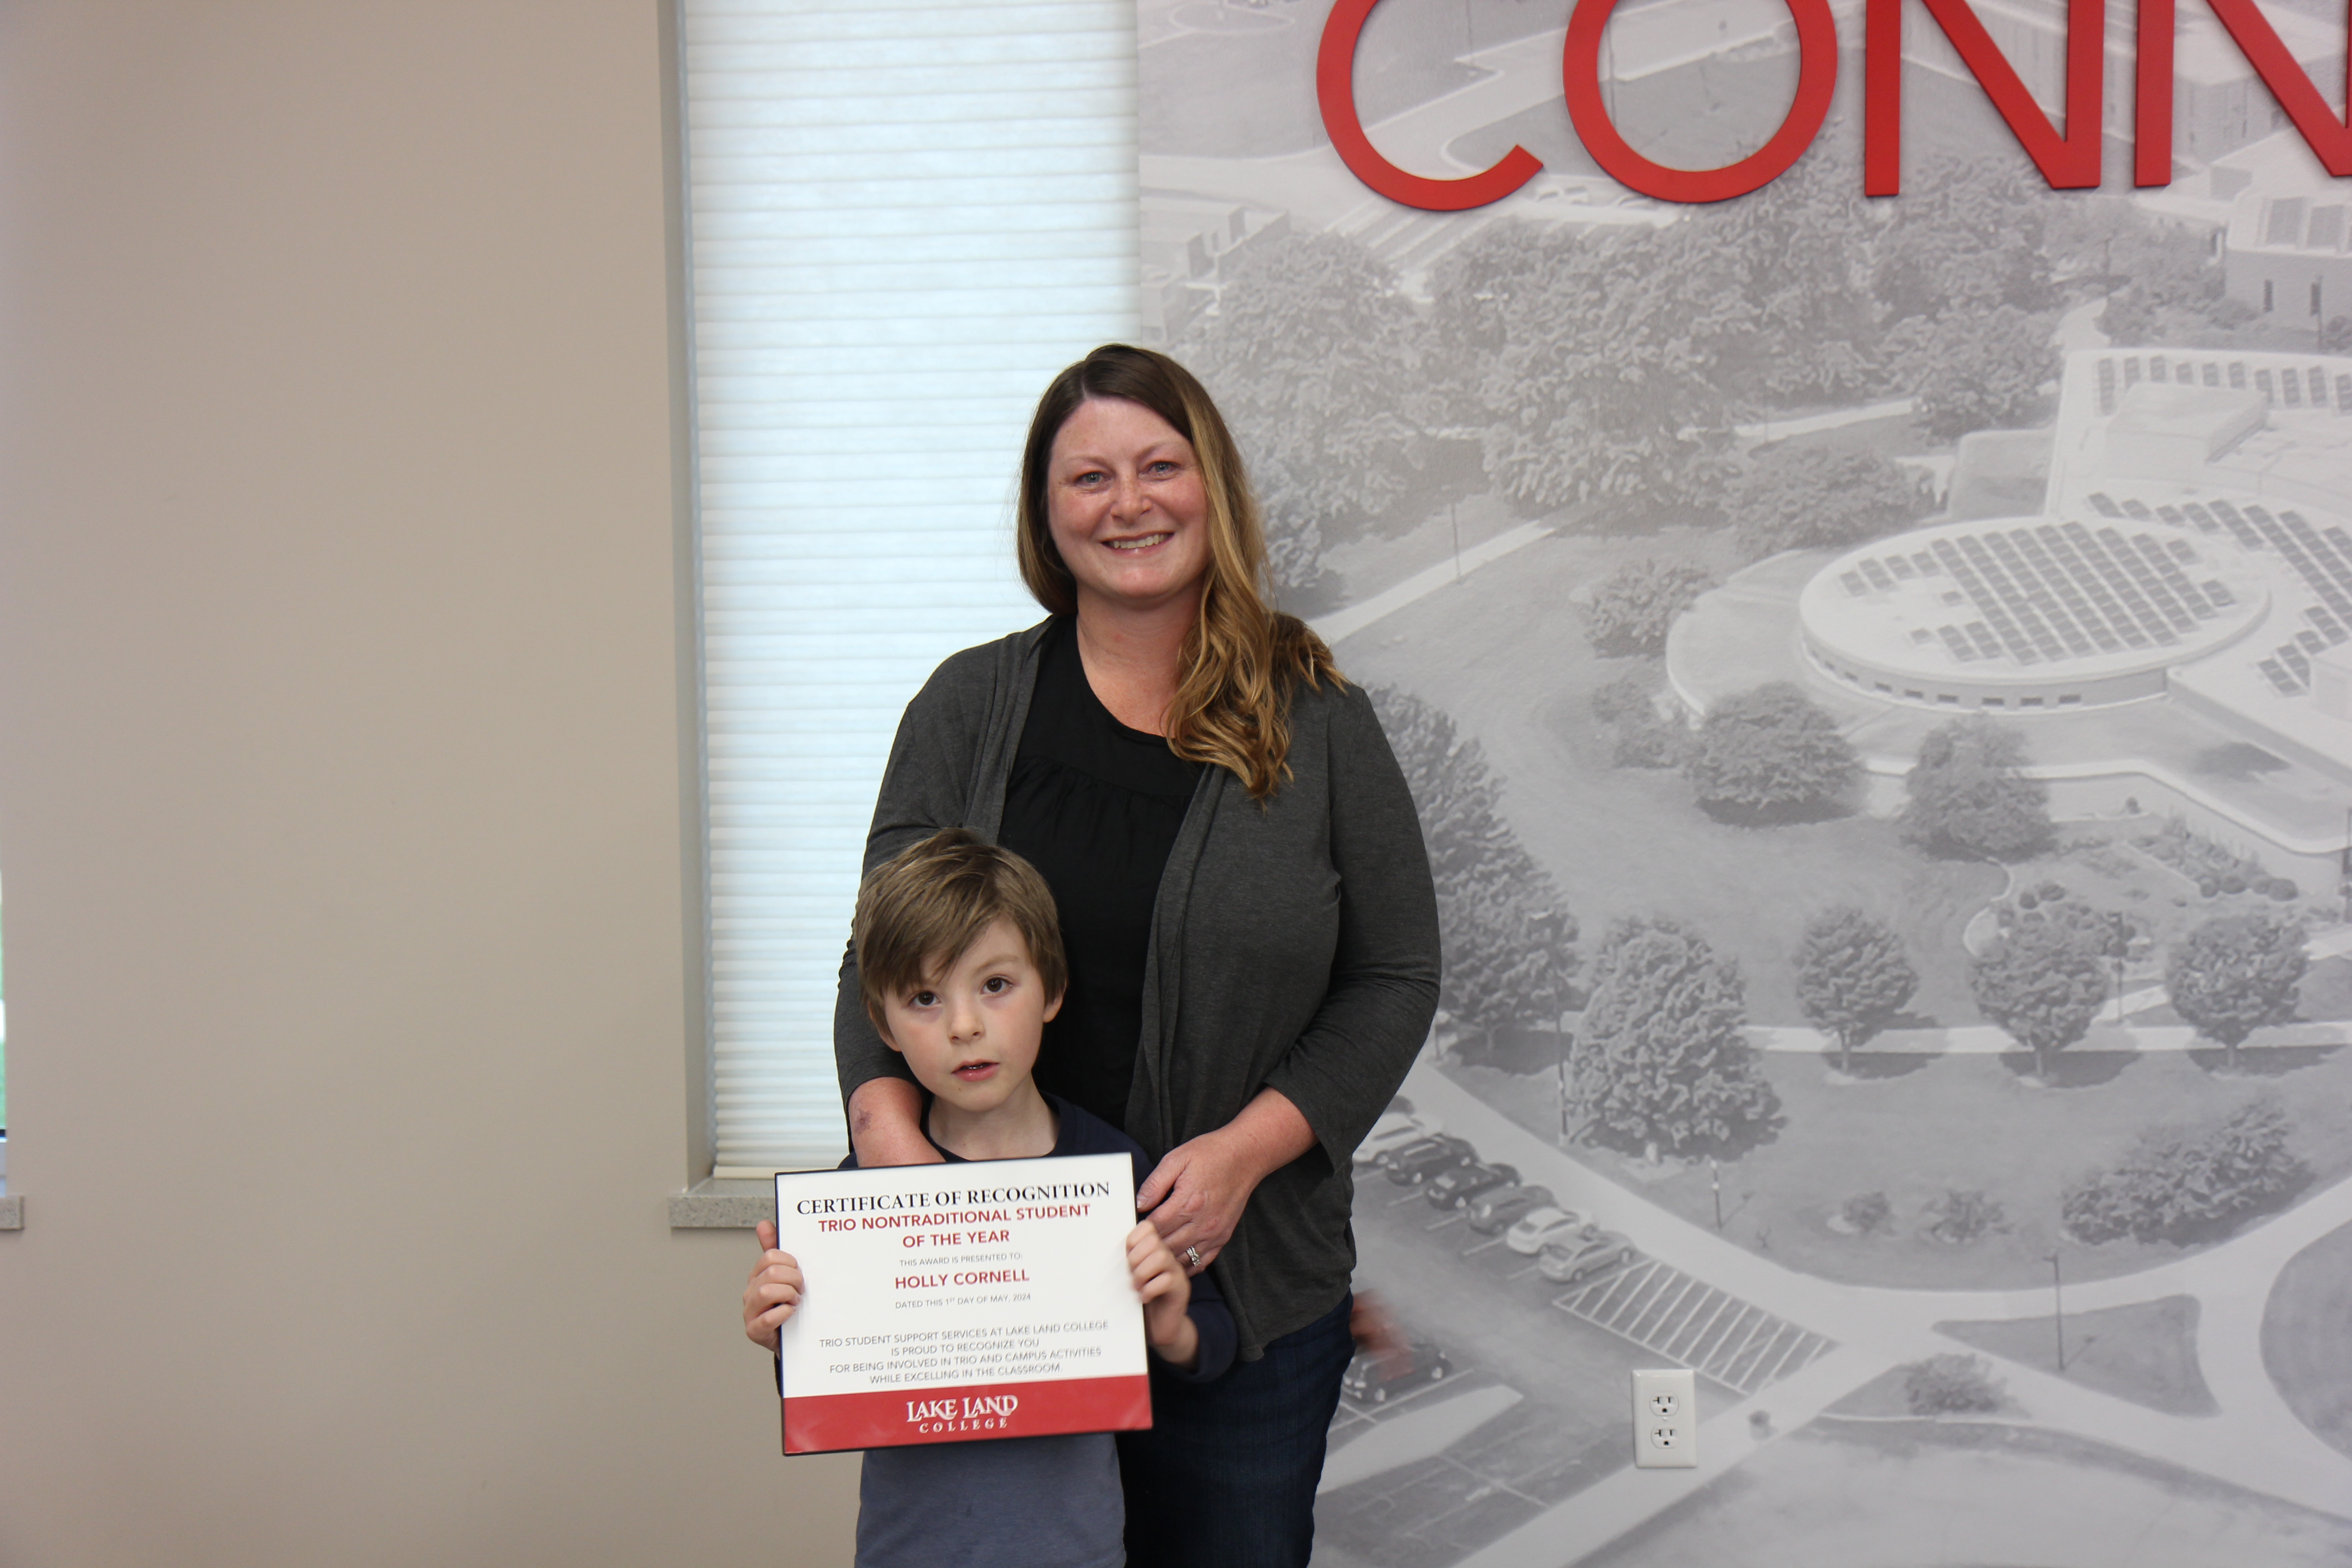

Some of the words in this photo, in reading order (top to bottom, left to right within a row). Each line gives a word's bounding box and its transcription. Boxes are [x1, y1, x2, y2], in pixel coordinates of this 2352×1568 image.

[797, 1193, 930, 1215] CERTIFICATE
[935, 1190, 961, 1206] OF
[967, 1181, 1109, 1204] RECOGNITION
[818, 1219, 856, 1232] TRIO
[862, 1209, 1011, 1230] NONTRADITIONAL
[1016, 1203, 1090, 1220] STUDENT
[903, 1235, 925, 1248] OF
[931, 1233, 961, 1246] THE
[967, 1229, 1009, 1244] YEAR
[919, 1257, 949, 1265] AWARD
[961, 1253, 1007, 1263] PRESENTED
[1010, 1252, 1022, 1260] TO:
[895, 1274, 949, 1289] HOLLY
[954, 1269, 1029, 1285] CORNELL
[895, 1300, 923, 1309] DATED
[925, 1298, 943, 1307] THIS
[958, 1296, 974, 1305] DAY
[976, 1294, 988, 1304] OF
[990, 1294, 1010, 1303] MAY,
[1013, 1293, 1031, 1302] 2024
[819, 1338, 843, 1348] TRIO
[845, 1335, 892, 1346] STUDENT
[894, 1331, 939, 1343] SUPPORT
[941, 1328, 987, 1340] SERVICES
[990, 1327, 1003, 1336] AT
[1006, 1324, 1029, 1336] LAKE
[1033, 1323, 1061, 1334] LAND
[1063, 1319, 1108, 1332] COLLEGE
[891, 1347, 899, 1356] IS
[903, 1345, 937, 1356] PROUD
[940, 1343, 954, 1352] TO
[957, 1339, 1014, 1352] RECOGNIZE
[1018, 1337, 1039, 1348] YOU
[830, 1364, 850, 1373] FOR
[853, 1362, 883, 1372] BEING
[887, 1358, 937, 1370] INVOLVED
[941, 1357, 951, 1366] IN
[954, 1354, 977, 1365] TRIO
[980, 1353, 1002, 1363] AND
[1005, 1349, 1047, 1362] CAMPUS
[1049, 1346, 1101, 1359] ACTIVITIES
[870, 1373, 901, 1384] WHILE
[905, 1369, 959, 1382] EXCELLING
[963, 1368, 972, 1378] IN
[975, 1367, 995, 1377] THE
[906, 1399, 958, 1422] LAKE
[962, 1395, 1019, 1418] LAND
[919, 1417, 1008, 1433] COLLEGE
